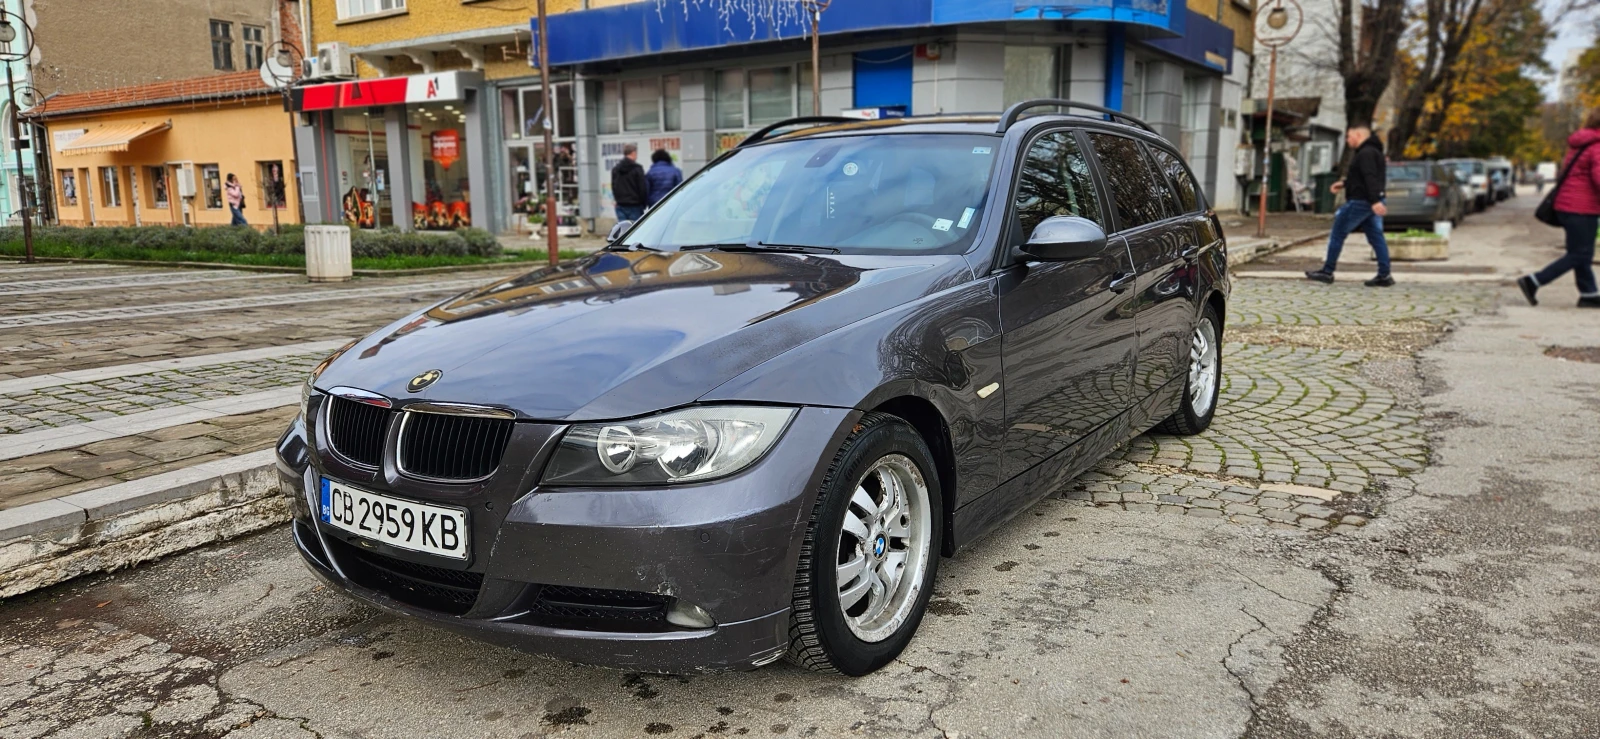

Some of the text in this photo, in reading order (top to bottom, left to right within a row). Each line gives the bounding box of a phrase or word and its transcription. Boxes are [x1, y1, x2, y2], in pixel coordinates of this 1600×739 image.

[427, 76, 439, 99] A1
[322, 505, 330, 516] BG
[332, 488, 459, 551] CB 2959 KB
